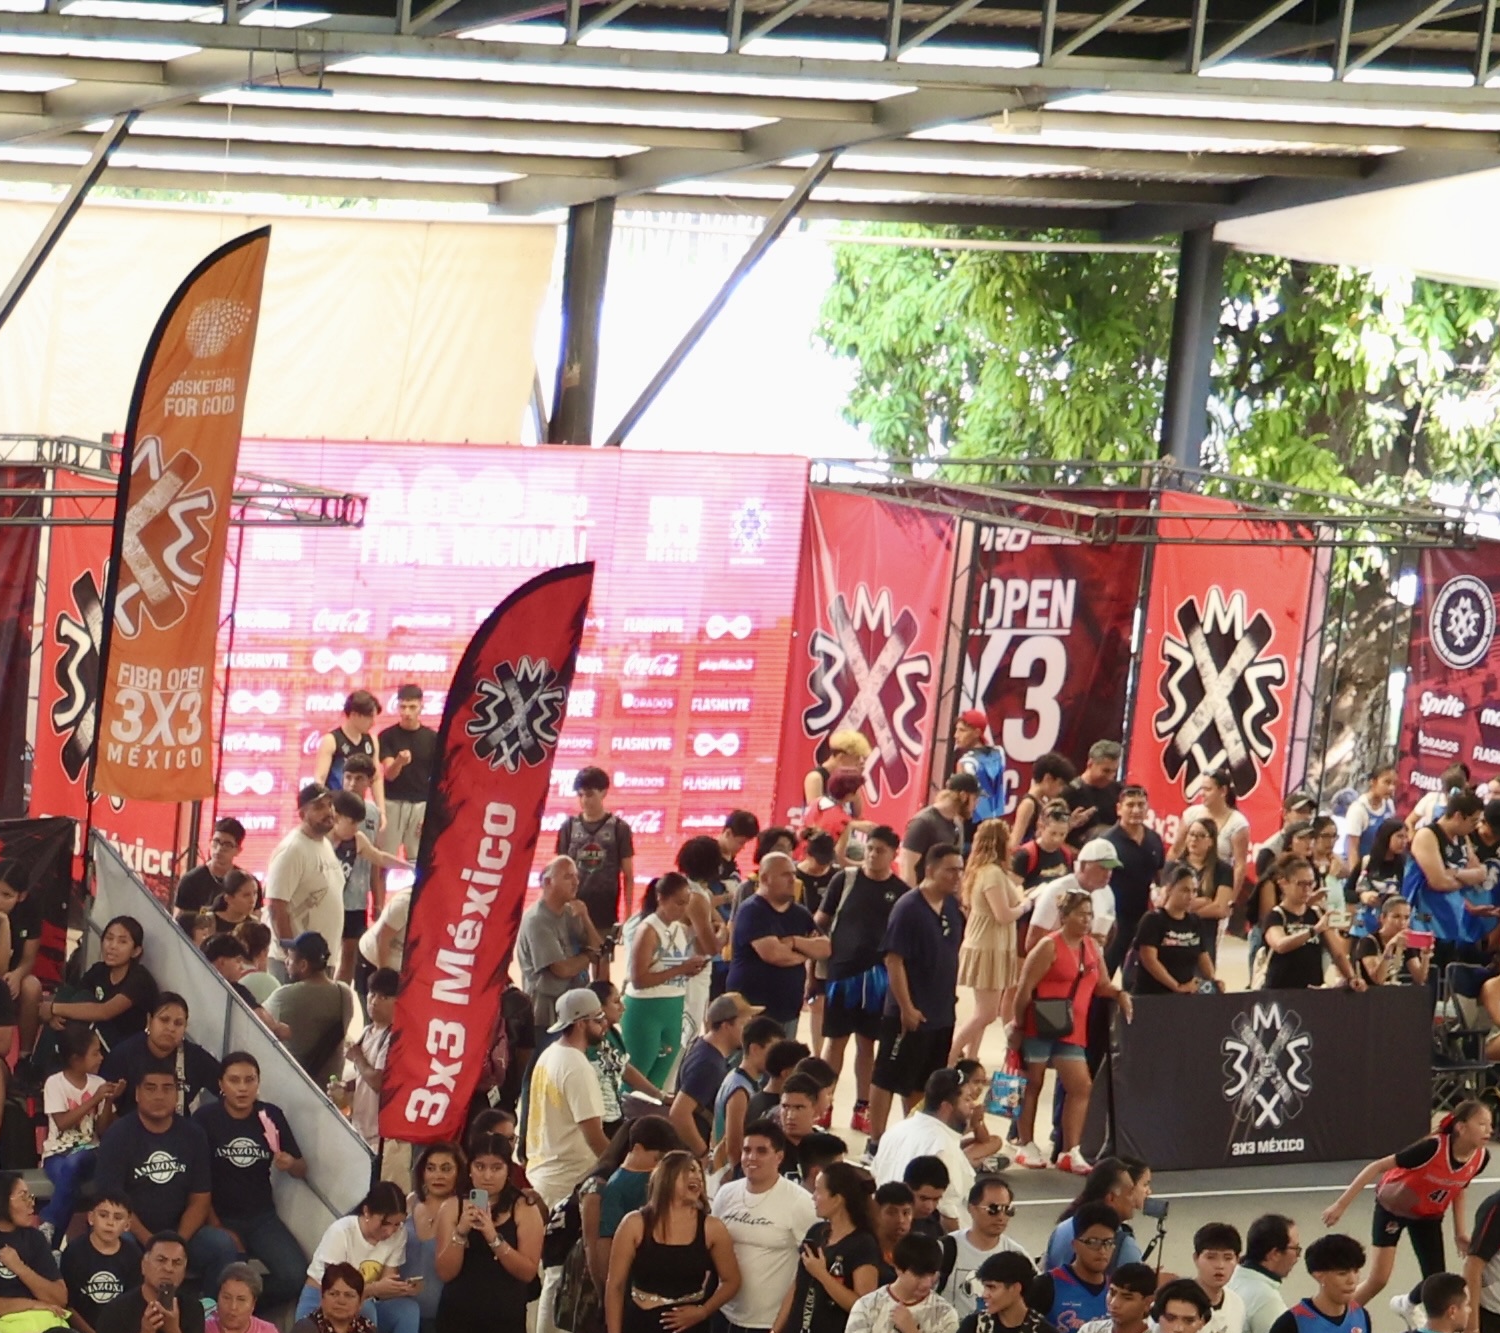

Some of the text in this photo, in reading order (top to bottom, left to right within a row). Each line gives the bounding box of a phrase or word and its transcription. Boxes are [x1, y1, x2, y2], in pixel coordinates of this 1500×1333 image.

[164, 398, 198, 417] FOR
[117, 662, 162, 690] FIBA
[110, 688, 203, 747] 3X3
[1419, 690, 1466, 718] Sprite
[404, 801, 517, 1127] 3x3 México
[1232, 1138, 1305, 1156] 3X3 MÉXICO
[722, 1210, 775, 1227] Hollister
